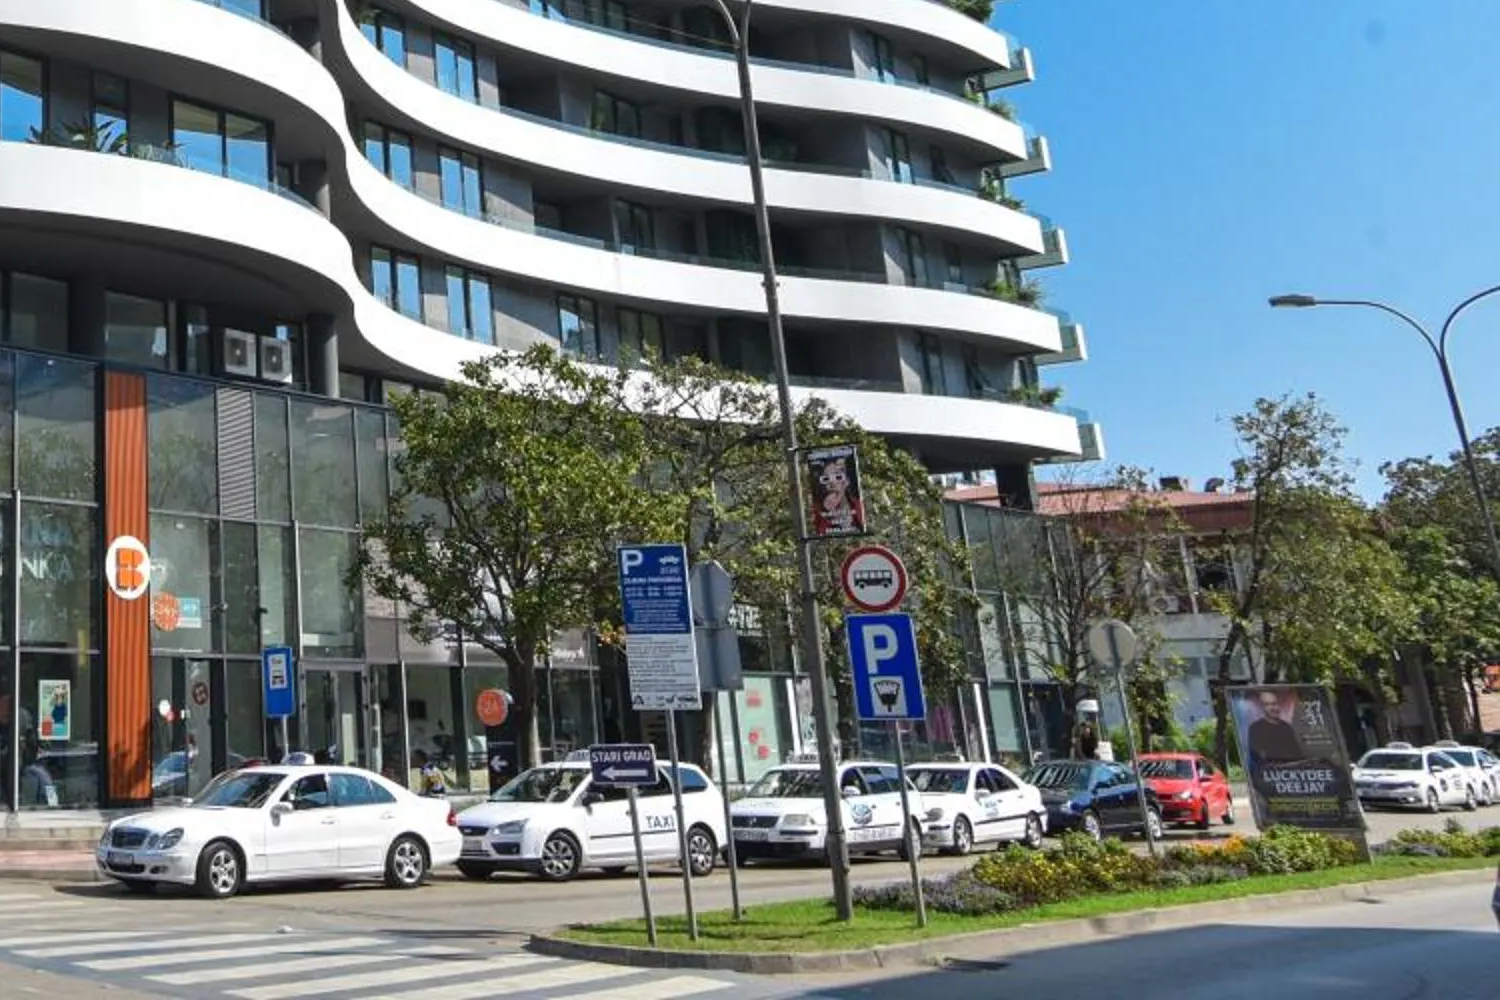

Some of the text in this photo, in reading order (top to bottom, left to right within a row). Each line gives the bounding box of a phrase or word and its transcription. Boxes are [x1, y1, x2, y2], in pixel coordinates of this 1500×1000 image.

[621, 549, 644, 575] P
[861, 623, 899, 675] P
[591, 751, 621, 763] STARI
[623, 750, 651, 761] GRAD
[1263, 769, 1333, 781] LUCKYDEE
[1275, 781, 1325, 793] DEEJAY
[646, 815, 675, 829] TAXI
